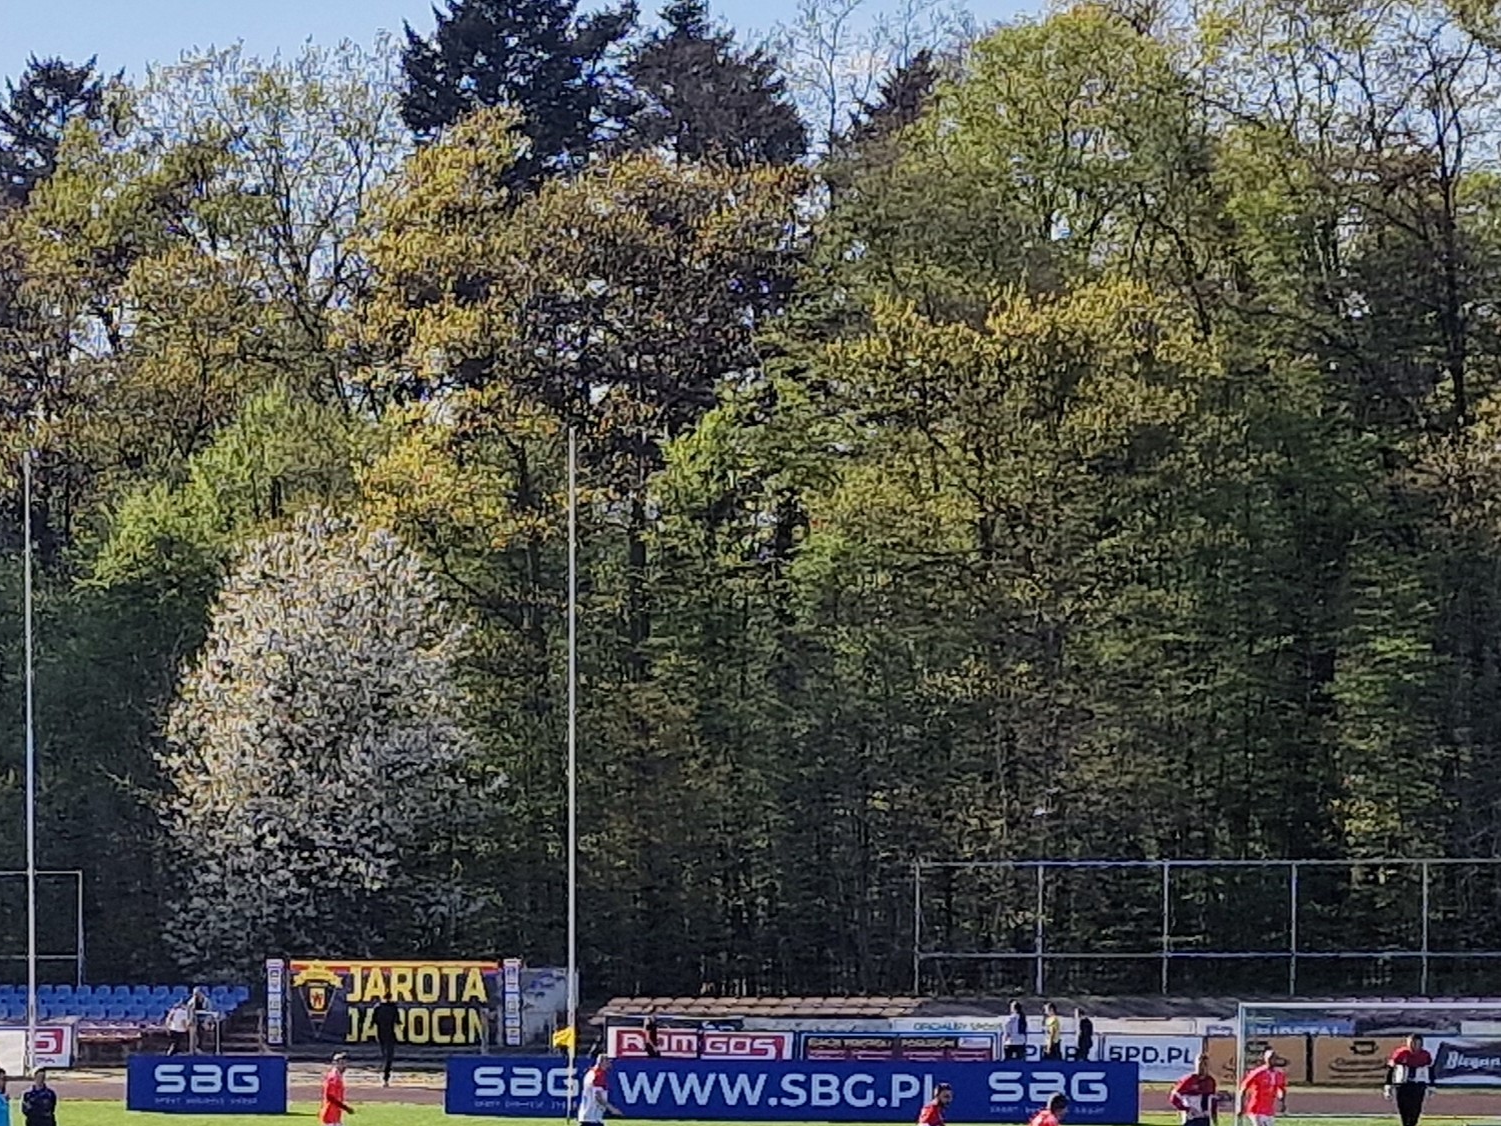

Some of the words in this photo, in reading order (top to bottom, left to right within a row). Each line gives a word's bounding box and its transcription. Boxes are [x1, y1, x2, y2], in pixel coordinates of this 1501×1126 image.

[345, 965, 489, 1003] JAROTA
[154, 1064, 260, 1093] SBG
[473, 1066, 579, 1097] SBG
[988, 1071, 1108, 1102] SBG
